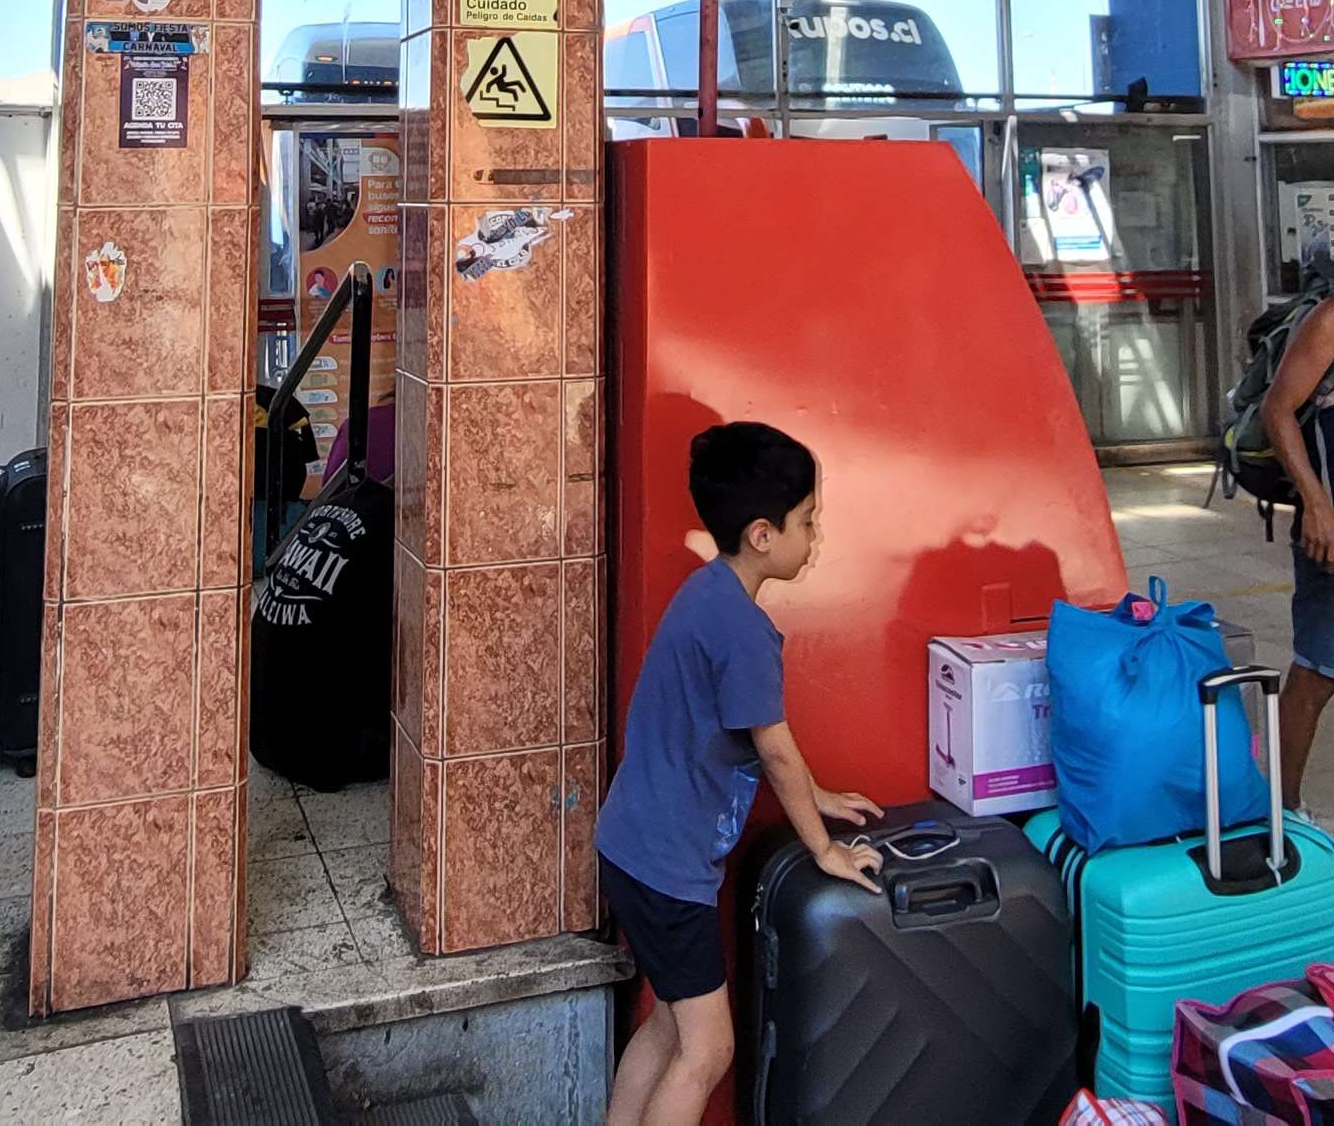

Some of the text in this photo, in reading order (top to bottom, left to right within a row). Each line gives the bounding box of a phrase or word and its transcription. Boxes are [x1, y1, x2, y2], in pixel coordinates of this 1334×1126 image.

[466, 10, 499, 22] Peligro
[502, 12, 514, 21] de
[122, 42, 179, 52] CARNAVAL
